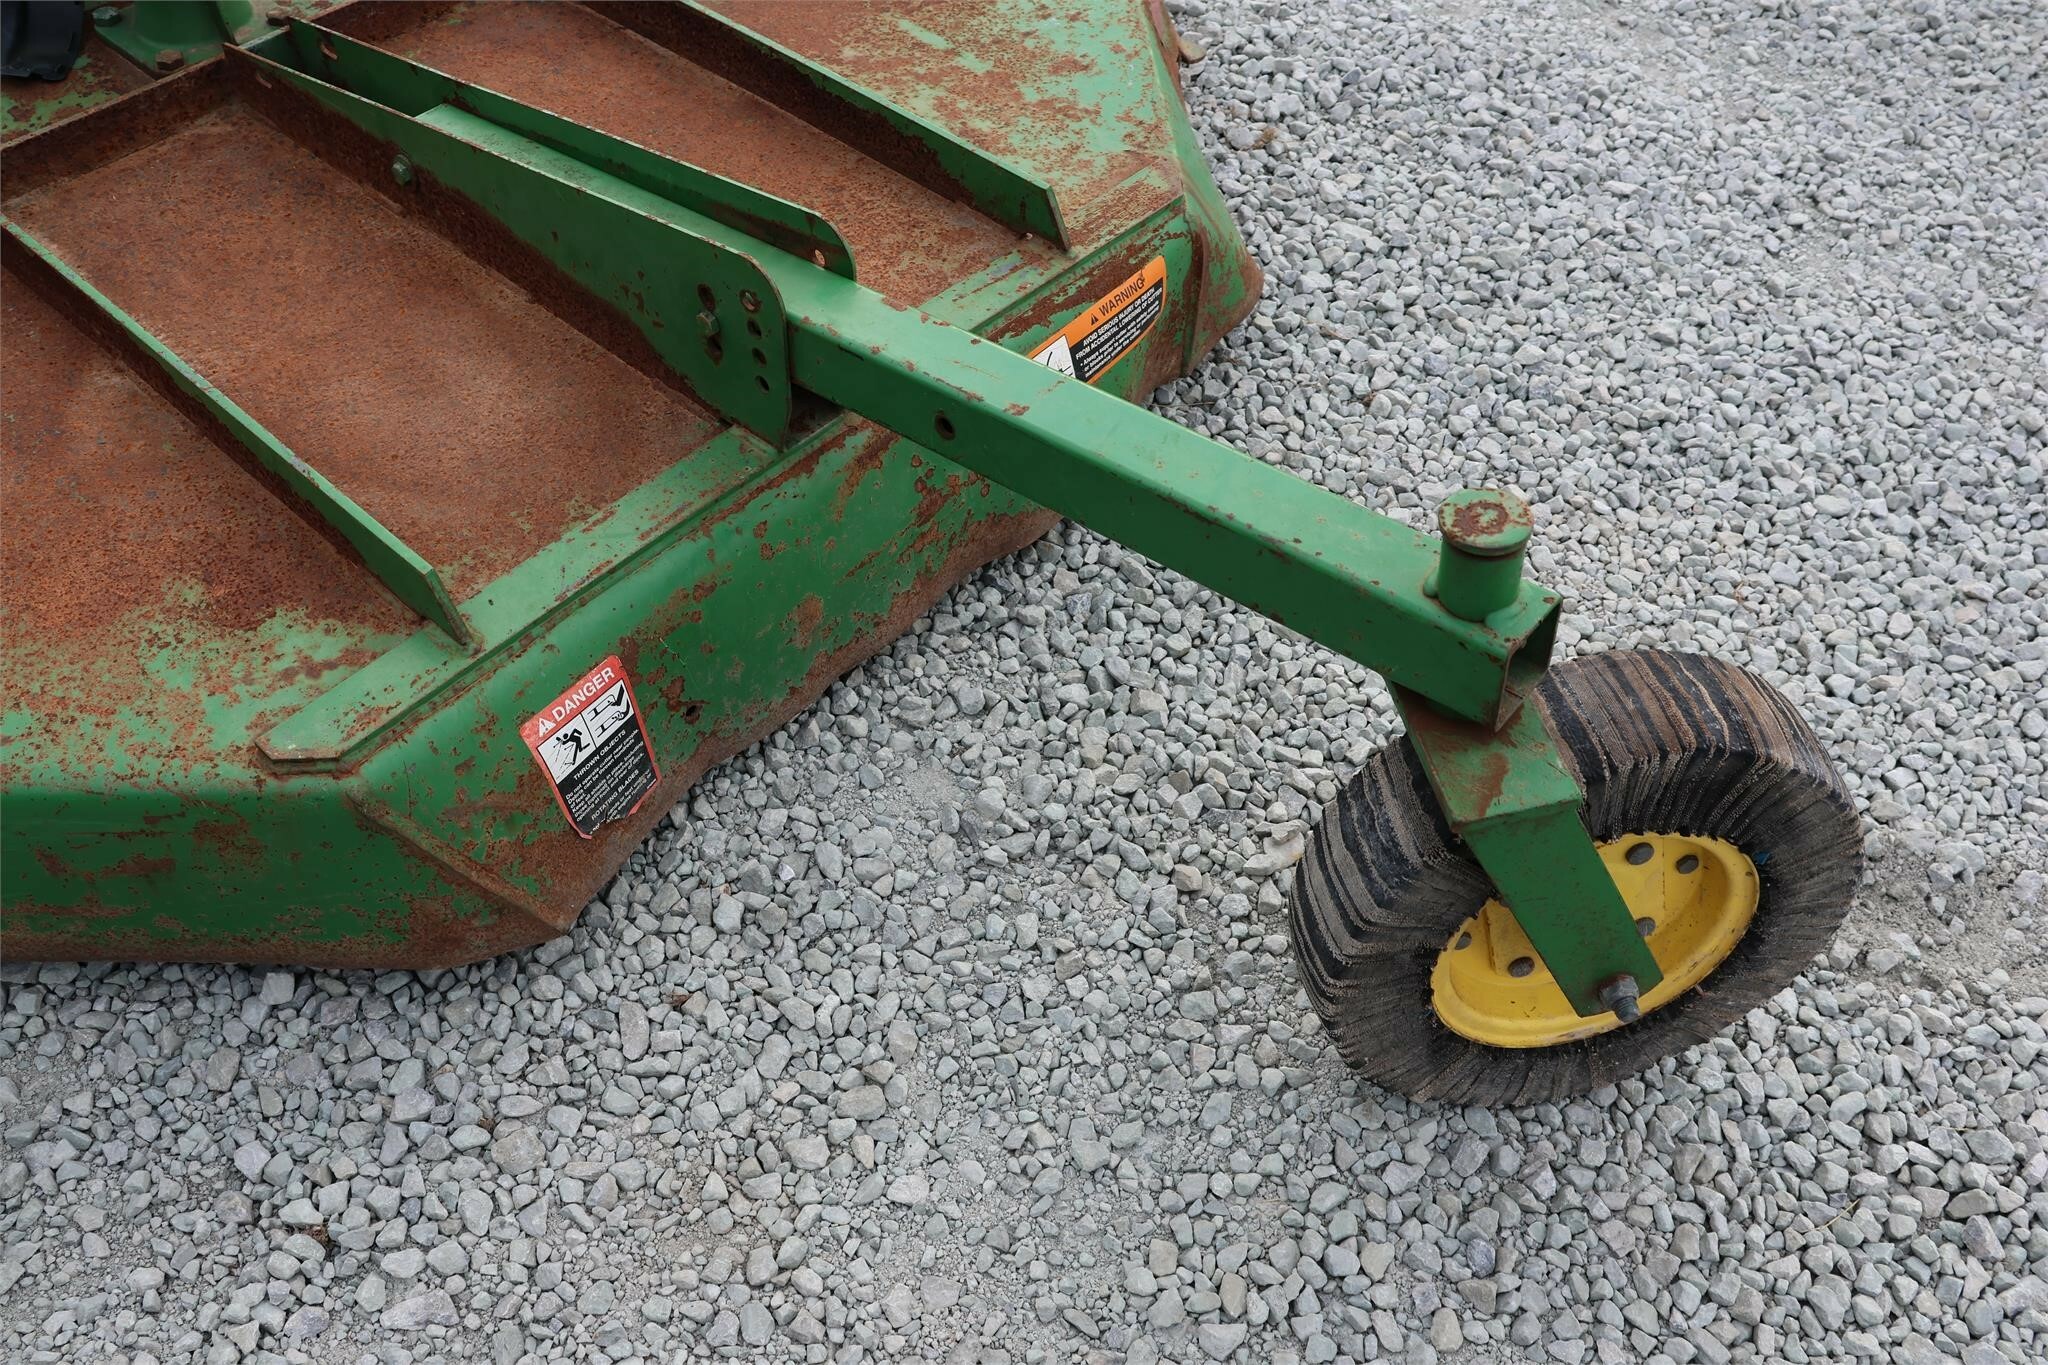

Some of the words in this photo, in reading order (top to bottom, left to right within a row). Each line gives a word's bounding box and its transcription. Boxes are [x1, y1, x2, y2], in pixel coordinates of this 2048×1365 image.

[1099, 278, 1145, 316] WARNING
[1076, 345, 1090, 361] FROM
[1091, 323, 1119, 350] ACCIDENTAL
[1083, 331, 1098, 347] AVOID
[1098, 316, 1118, 336] SERIOUS
[552, 667, 615, 722] DANGER
[573, 754, 600, 781] THROWN
[599, 729, 626, 756] OBJECTS
[573, 783, 582, 793] not
[582, 767, 600, 786] operate
[599, 754, 613, 769] cutter
[583, 780, 592, 790] can
[599, 758, 615, 775] thrown
[572, 800, 585, 814] Keep
[591, 791, 619, 821] ROTATING
[617, 769, 639, 793] BLADES
